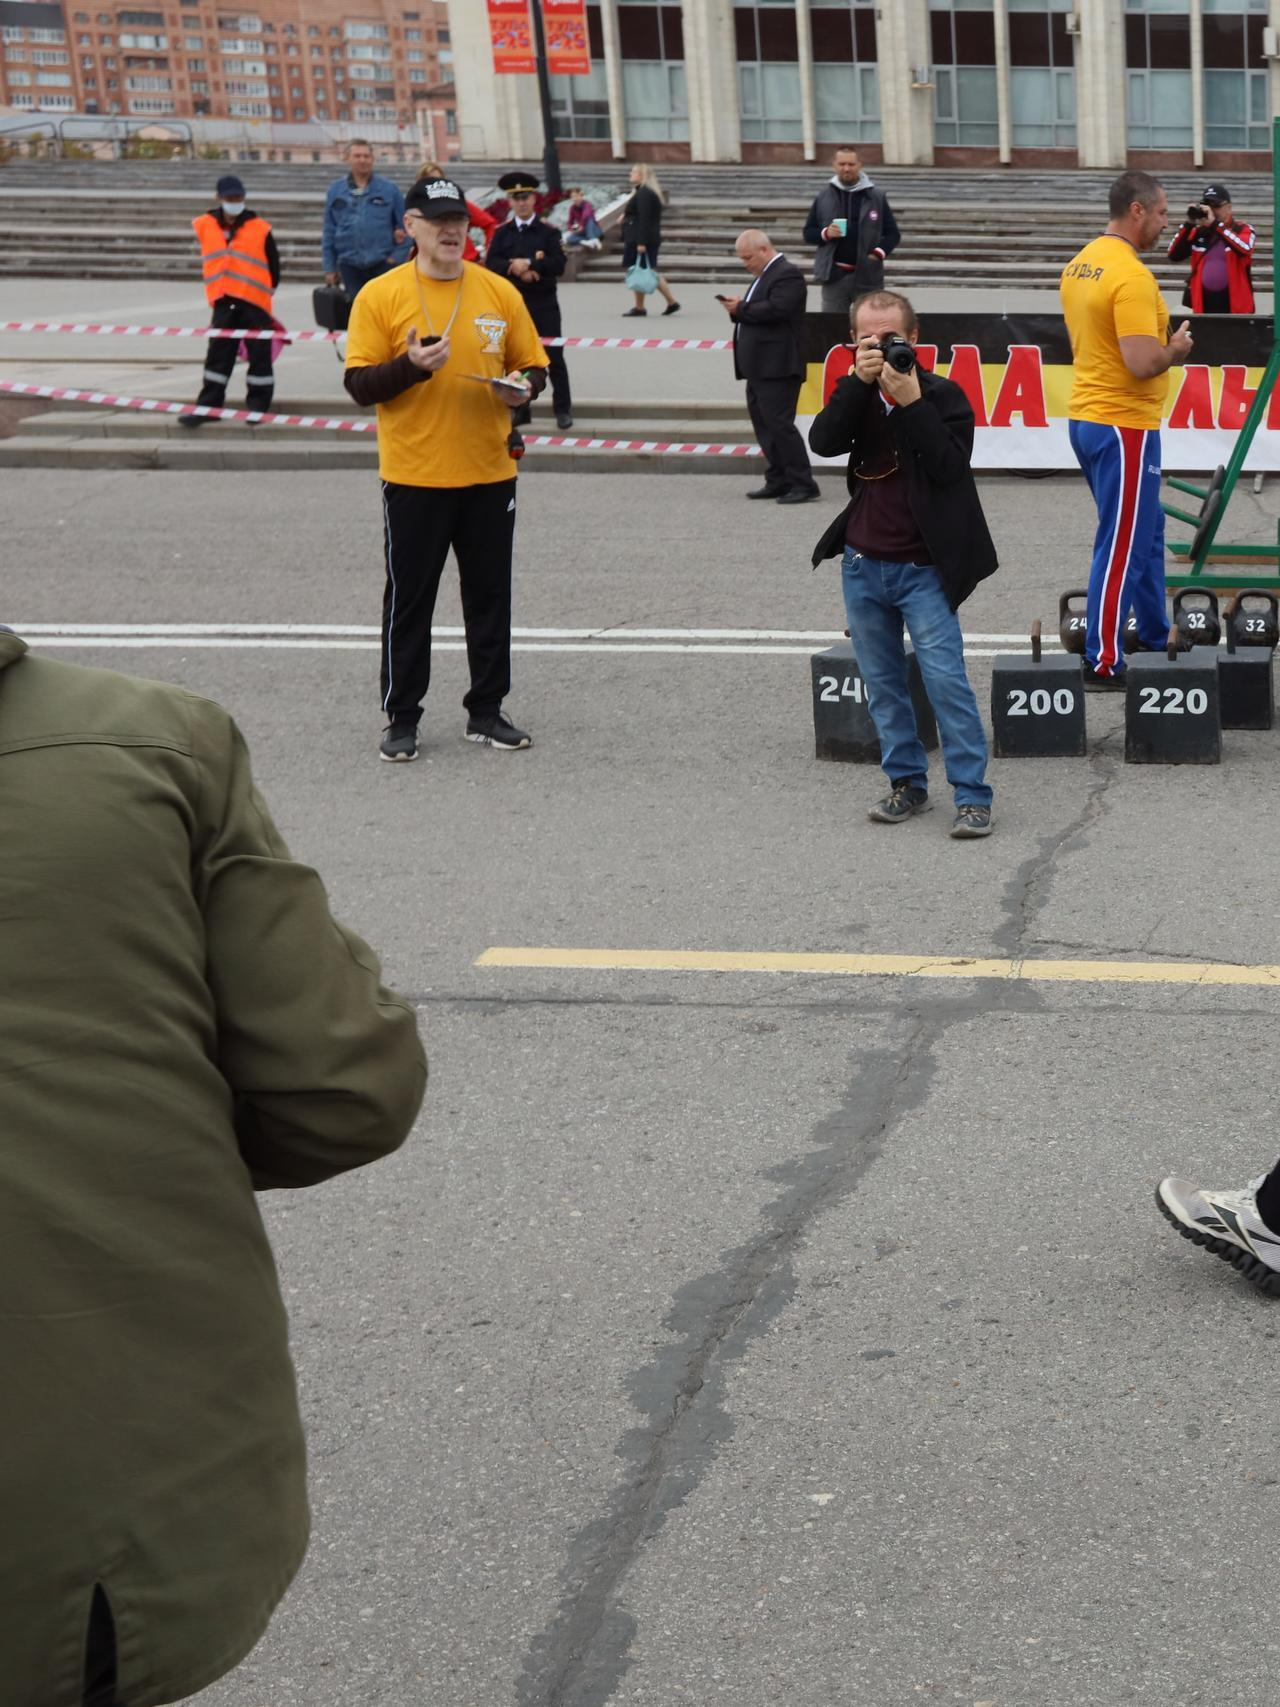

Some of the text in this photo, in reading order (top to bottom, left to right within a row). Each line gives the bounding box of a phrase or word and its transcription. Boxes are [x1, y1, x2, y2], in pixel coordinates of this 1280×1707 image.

[1065, 263, 1105, 281] СУДЬЯ
[1187, 613, 1206, 629] 32
[1245, 619, 1266, 632] 32
[819, 675, 868, 703] 24
[1007, 688, 1074, 717] 200
[1138, 686, 1209, 716] 220
